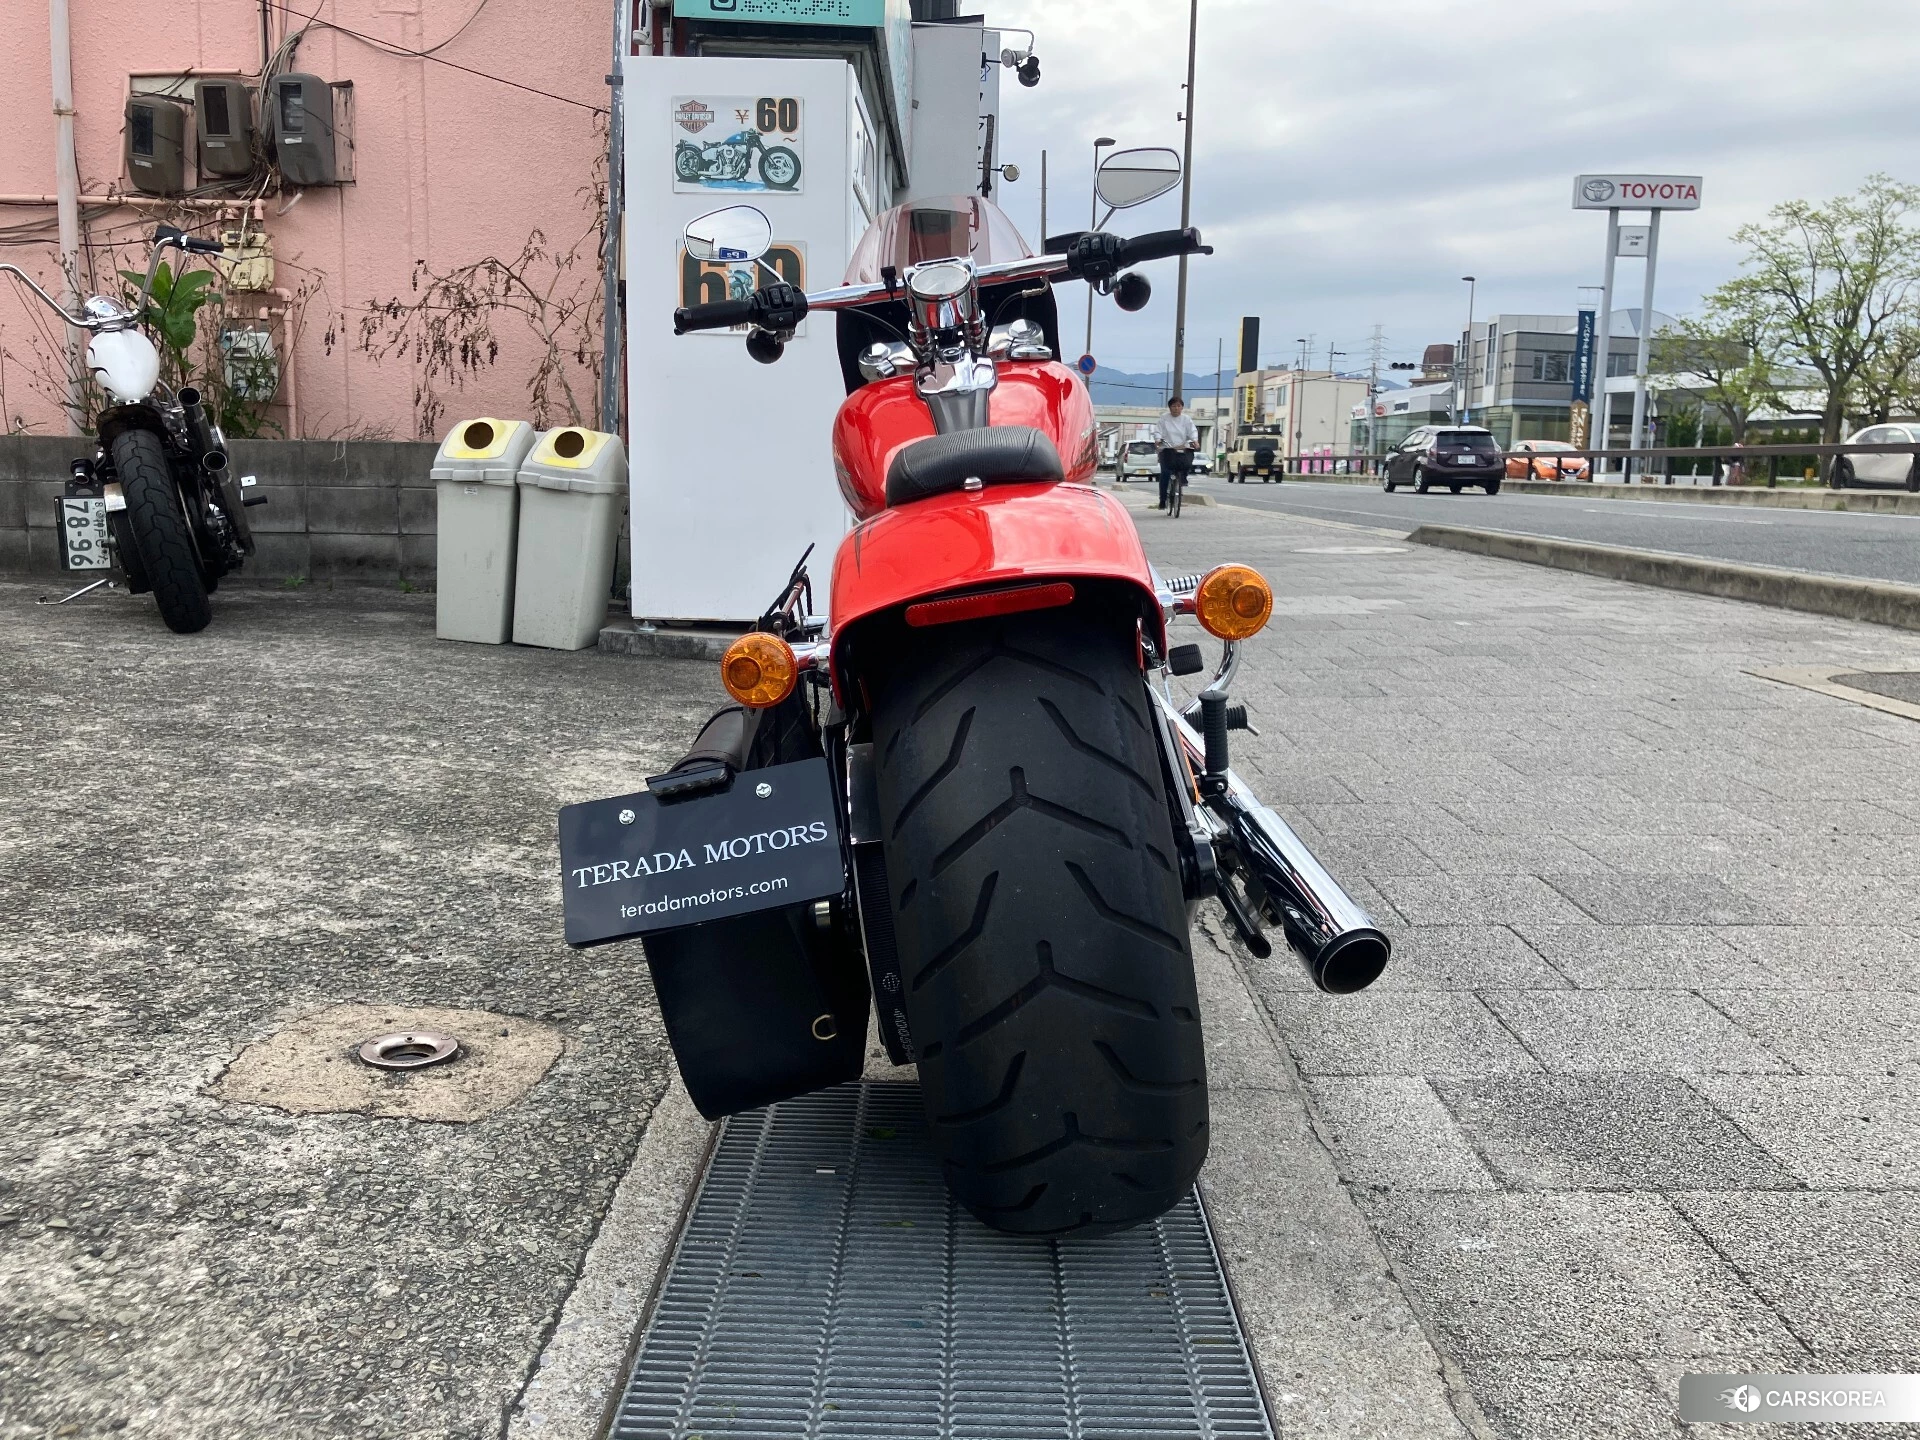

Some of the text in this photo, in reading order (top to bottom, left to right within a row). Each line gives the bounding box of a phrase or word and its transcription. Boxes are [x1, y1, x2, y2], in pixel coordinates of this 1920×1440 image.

[756, 97, 799, 134] 60
[1619, 183, 1698, 200] TOYOTA
[65, 501, 94, 567] 78-96
[572, 821, 828, 888] TERADA MOTORS
[620, 876, 789, 919] teradamotors.com
